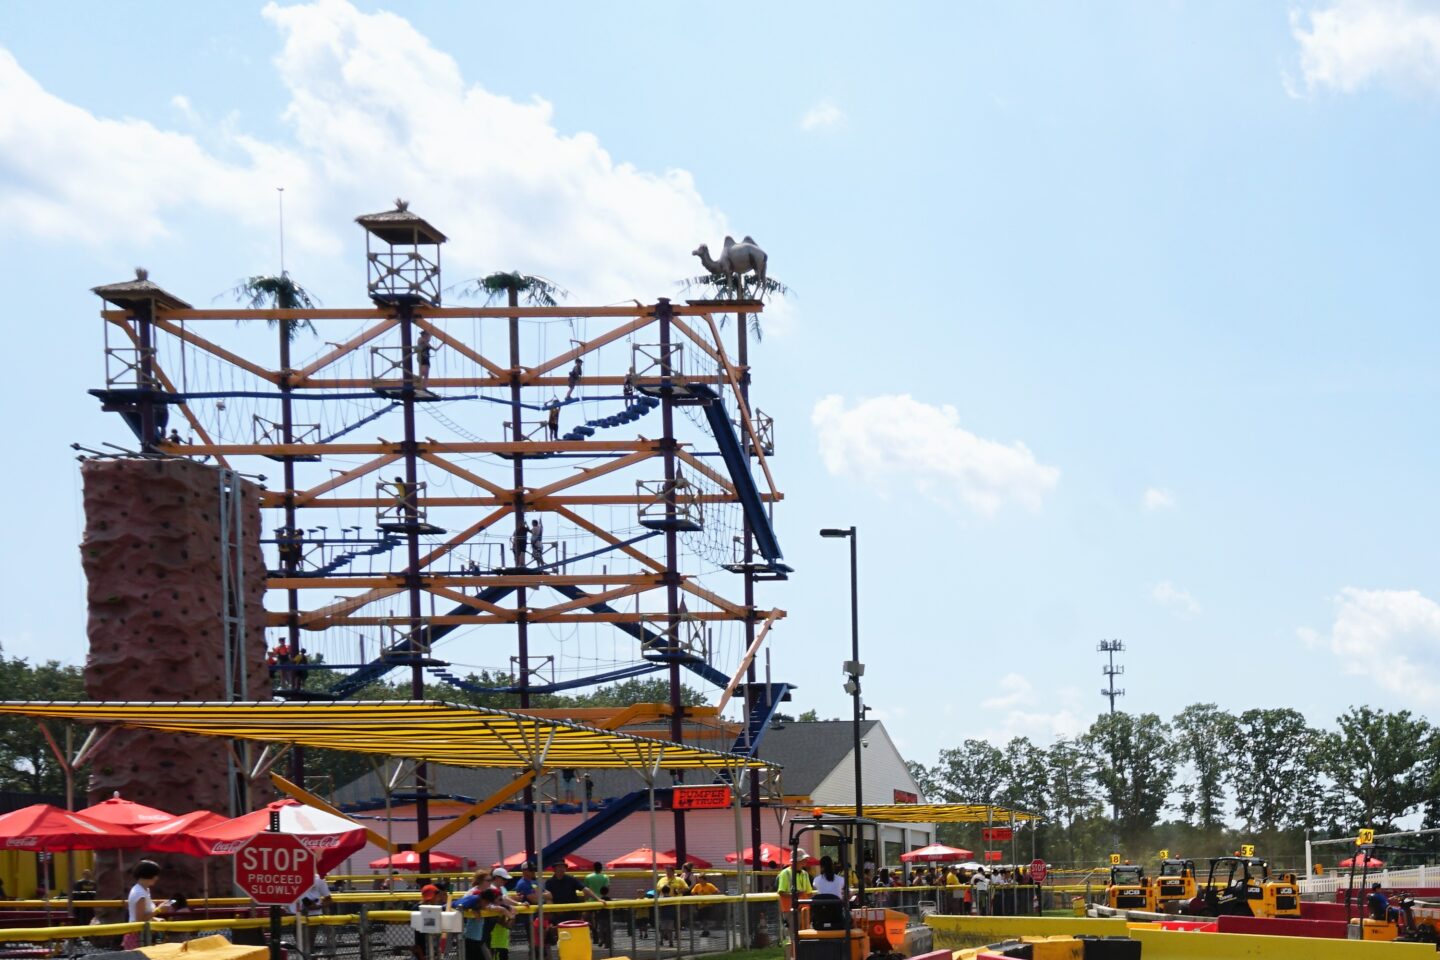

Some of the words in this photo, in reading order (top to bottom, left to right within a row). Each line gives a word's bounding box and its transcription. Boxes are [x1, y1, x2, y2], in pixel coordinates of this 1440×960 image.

[1363, 831, 1372, 842] 10
[212, 840, 245, 853] Coca-C
[243, 847, 308, 872] STOP
[1113, 855, 1119, 863] 8
[1031, 864, 1046, 872] STOP
[248, 874, 302, 885] PROCEED
[251, 885, 300, 895] SLOWLY
